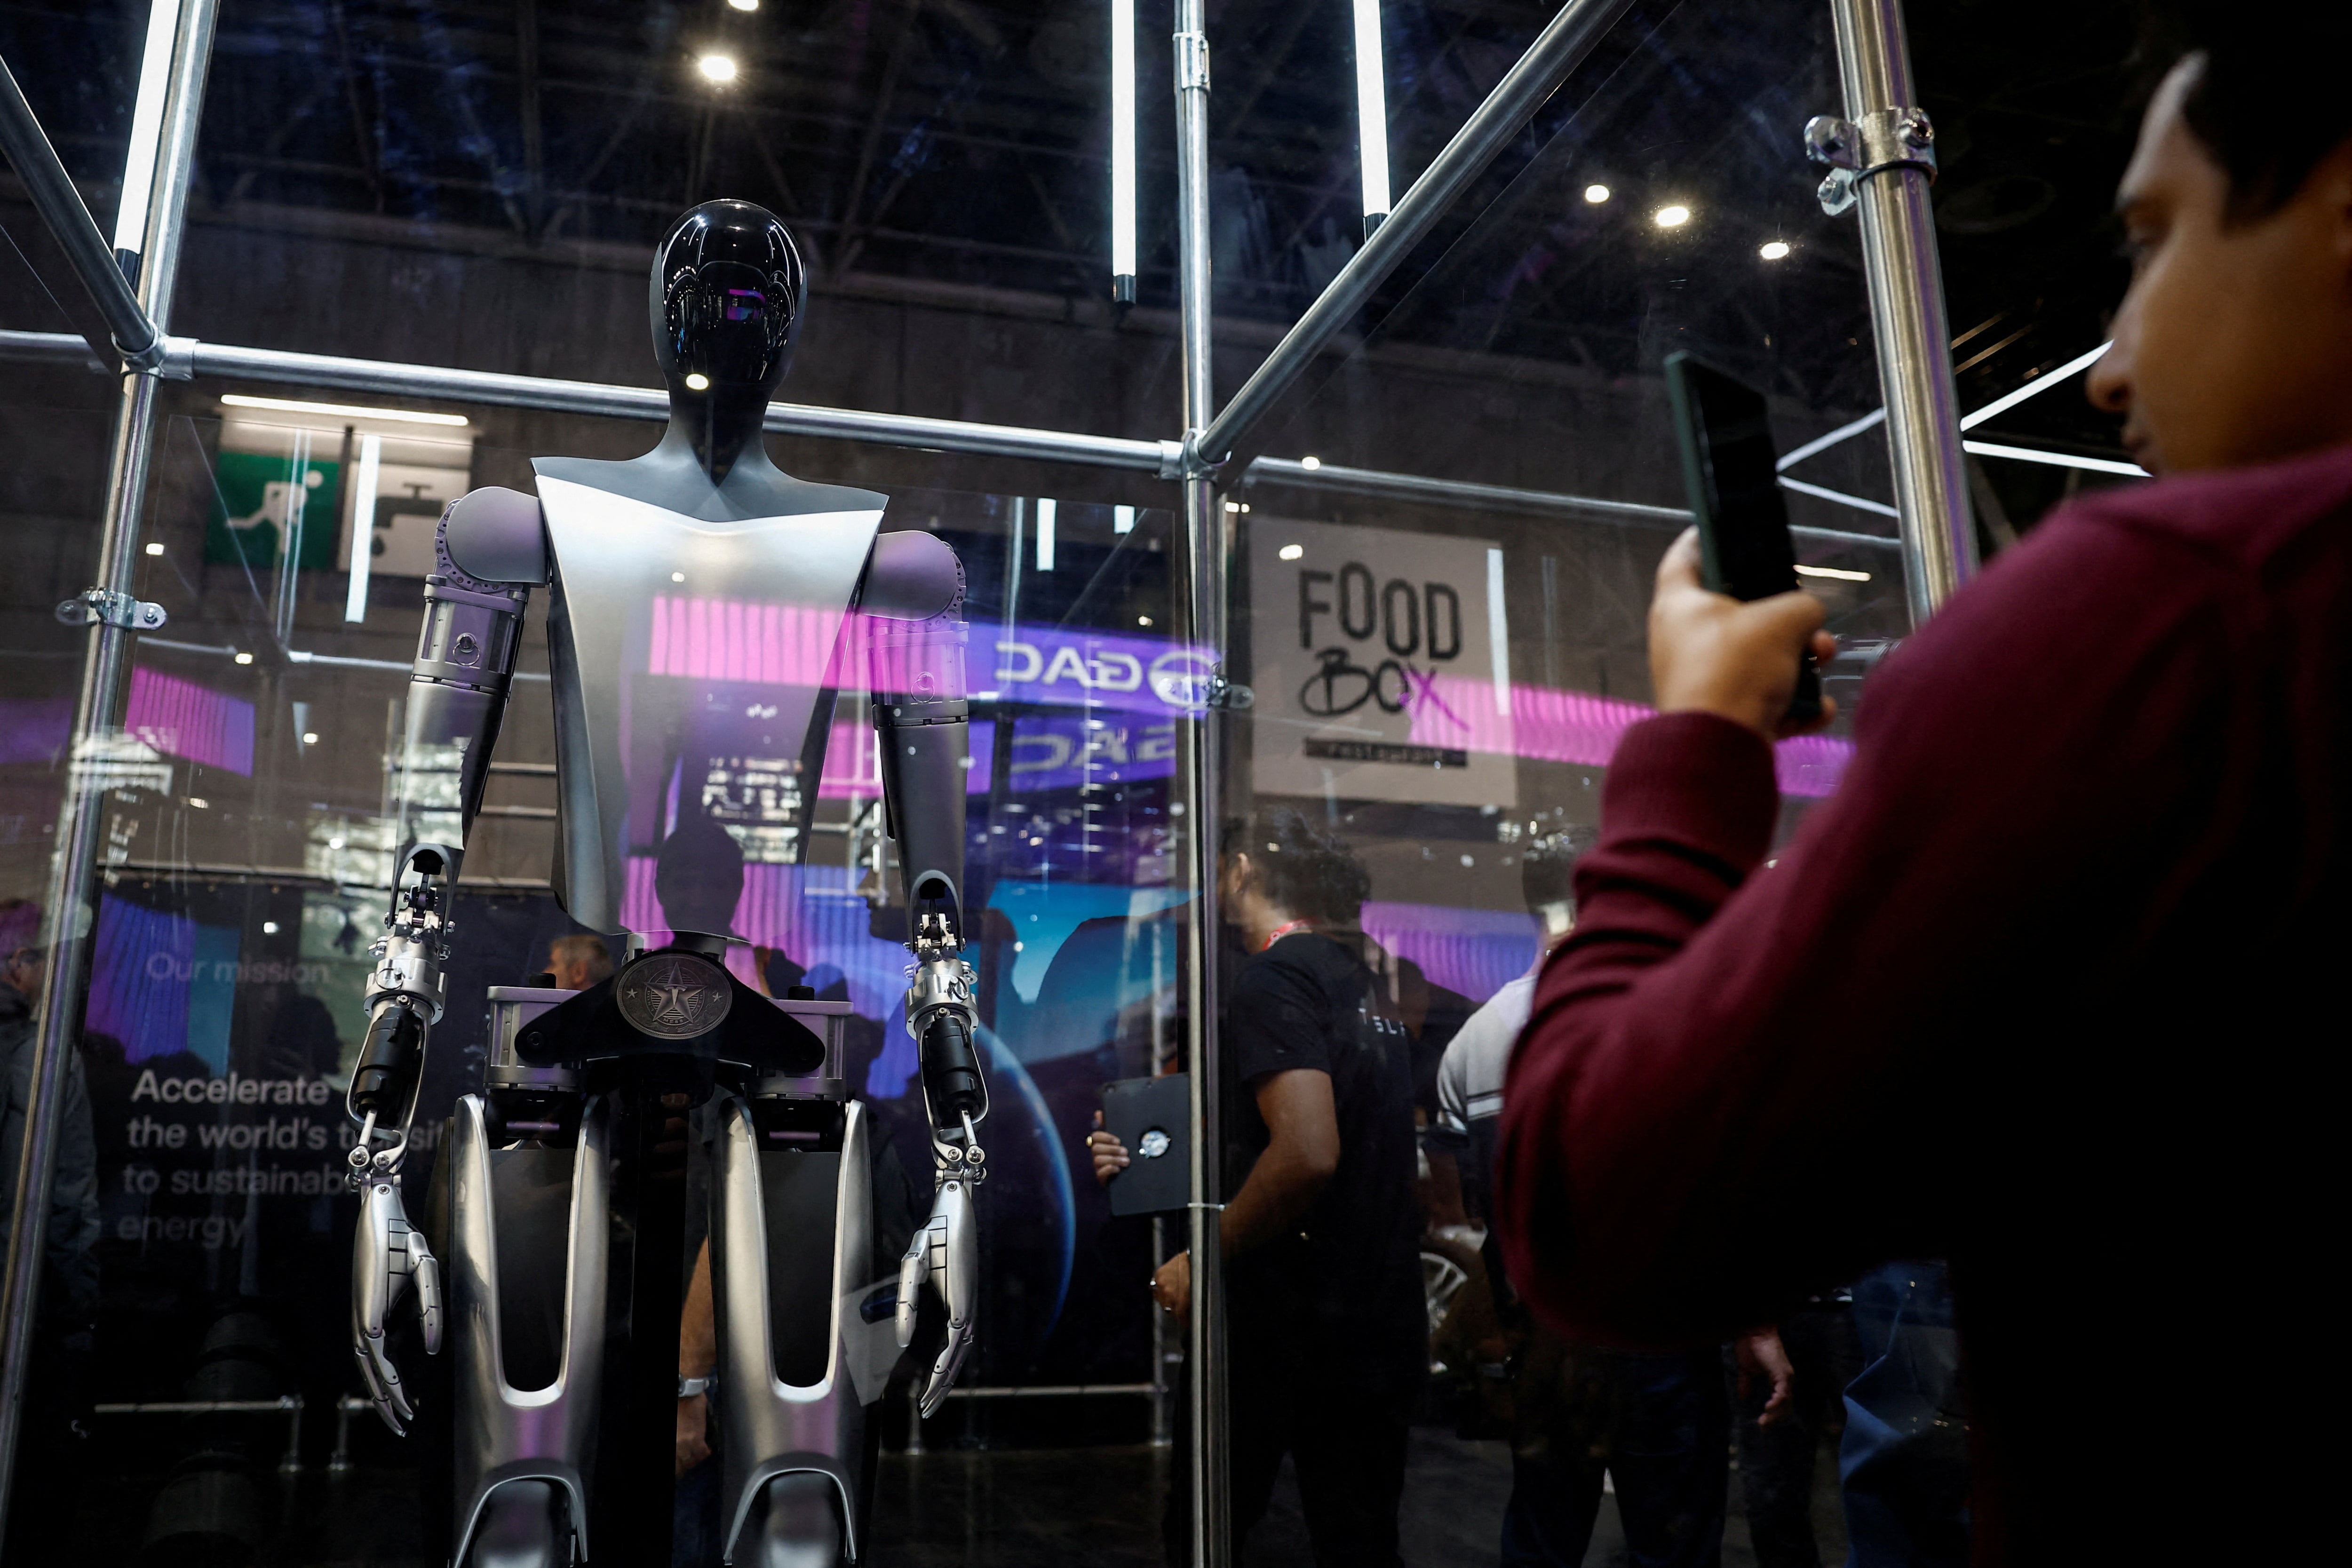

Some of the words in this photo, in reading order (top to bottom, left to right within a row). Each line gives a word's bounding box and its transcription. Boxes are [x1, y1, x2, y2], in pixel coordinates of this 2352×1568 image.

[1299, 562, 1461, 660] FOOD
[146, 951, 203, 981] Our
[214, 957, 328, 985] mission
[130, 1069, 329, 1106] Accelerate
[127, 1115, 189, 1149] the
[199, 1118, 327, 1151] world's
[122, 1166, 160, 1194] to
[171, 1163, 347, 1196] sustainab
[117, 1213, 245, 1248] energy
